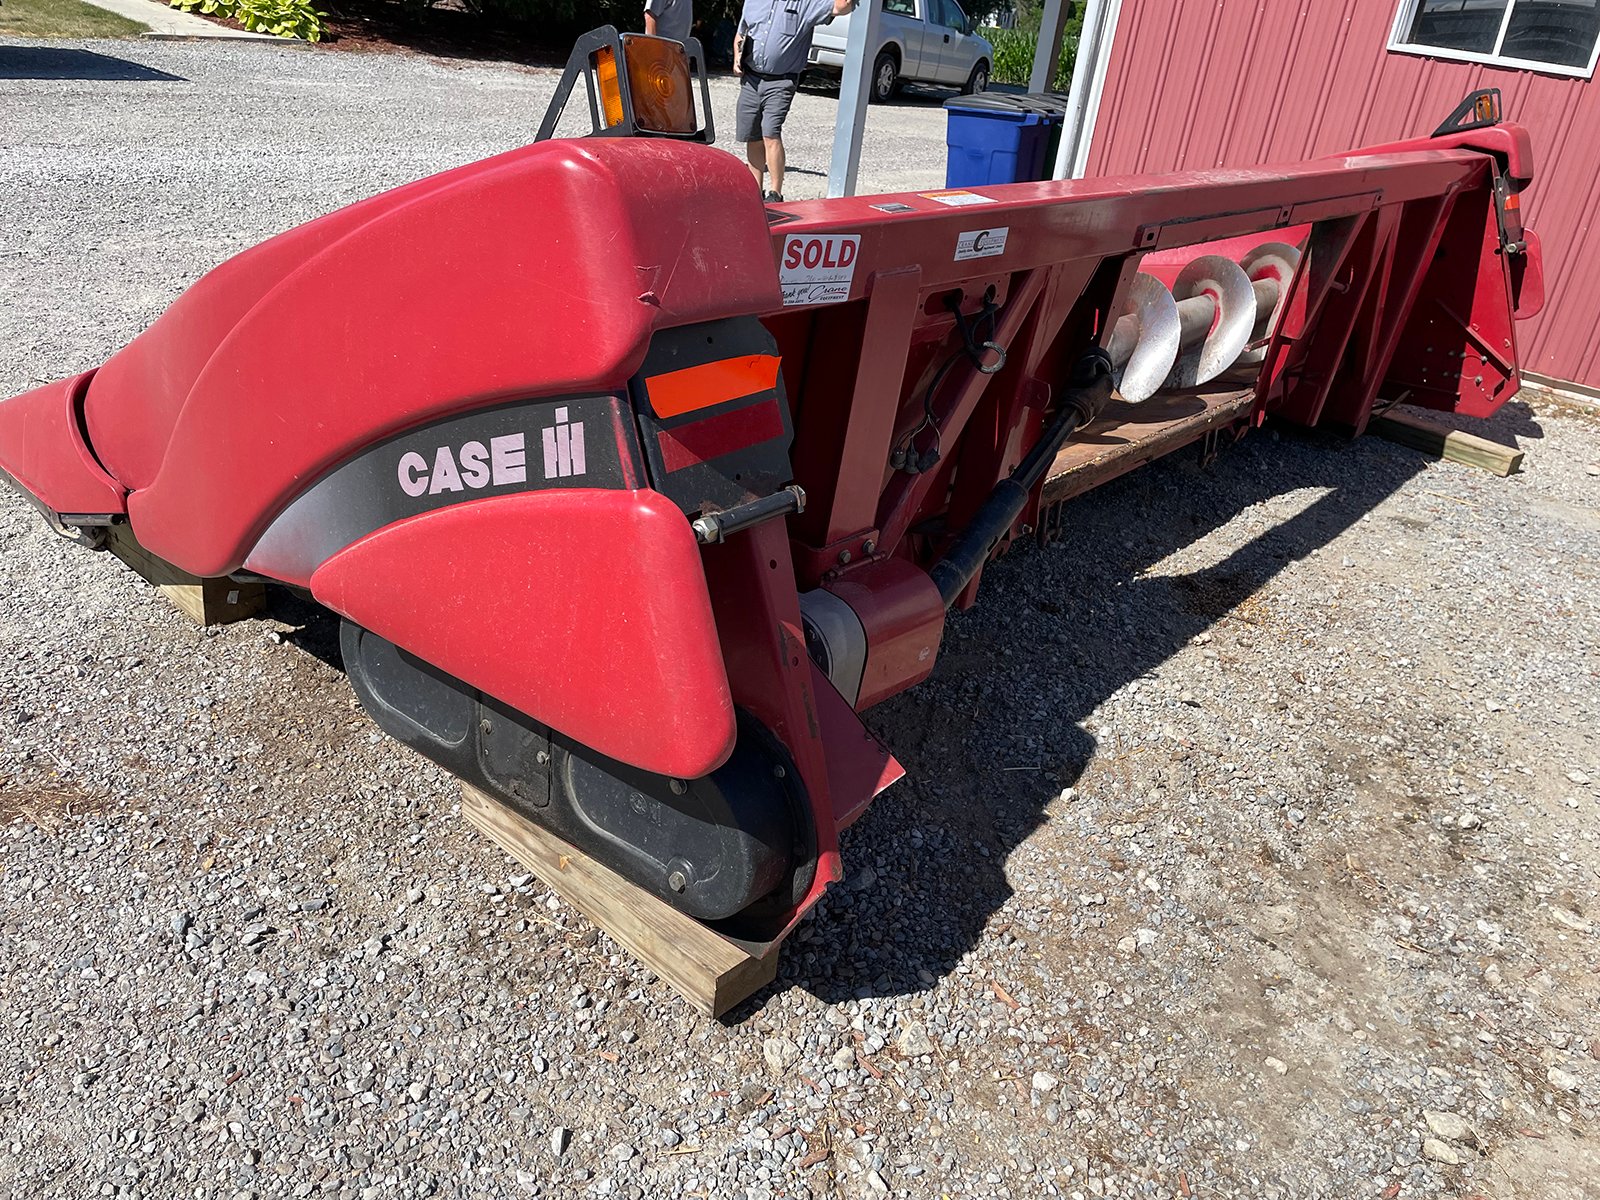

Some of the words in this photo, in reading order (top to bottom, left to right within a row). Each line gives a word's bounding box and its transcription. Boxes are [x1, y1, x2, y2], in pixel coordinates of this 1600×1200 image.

[785, 239, 856, 270] SOLD
[808, 285, 847, 301] Crane
[397, 432, 527, 497] CASE
